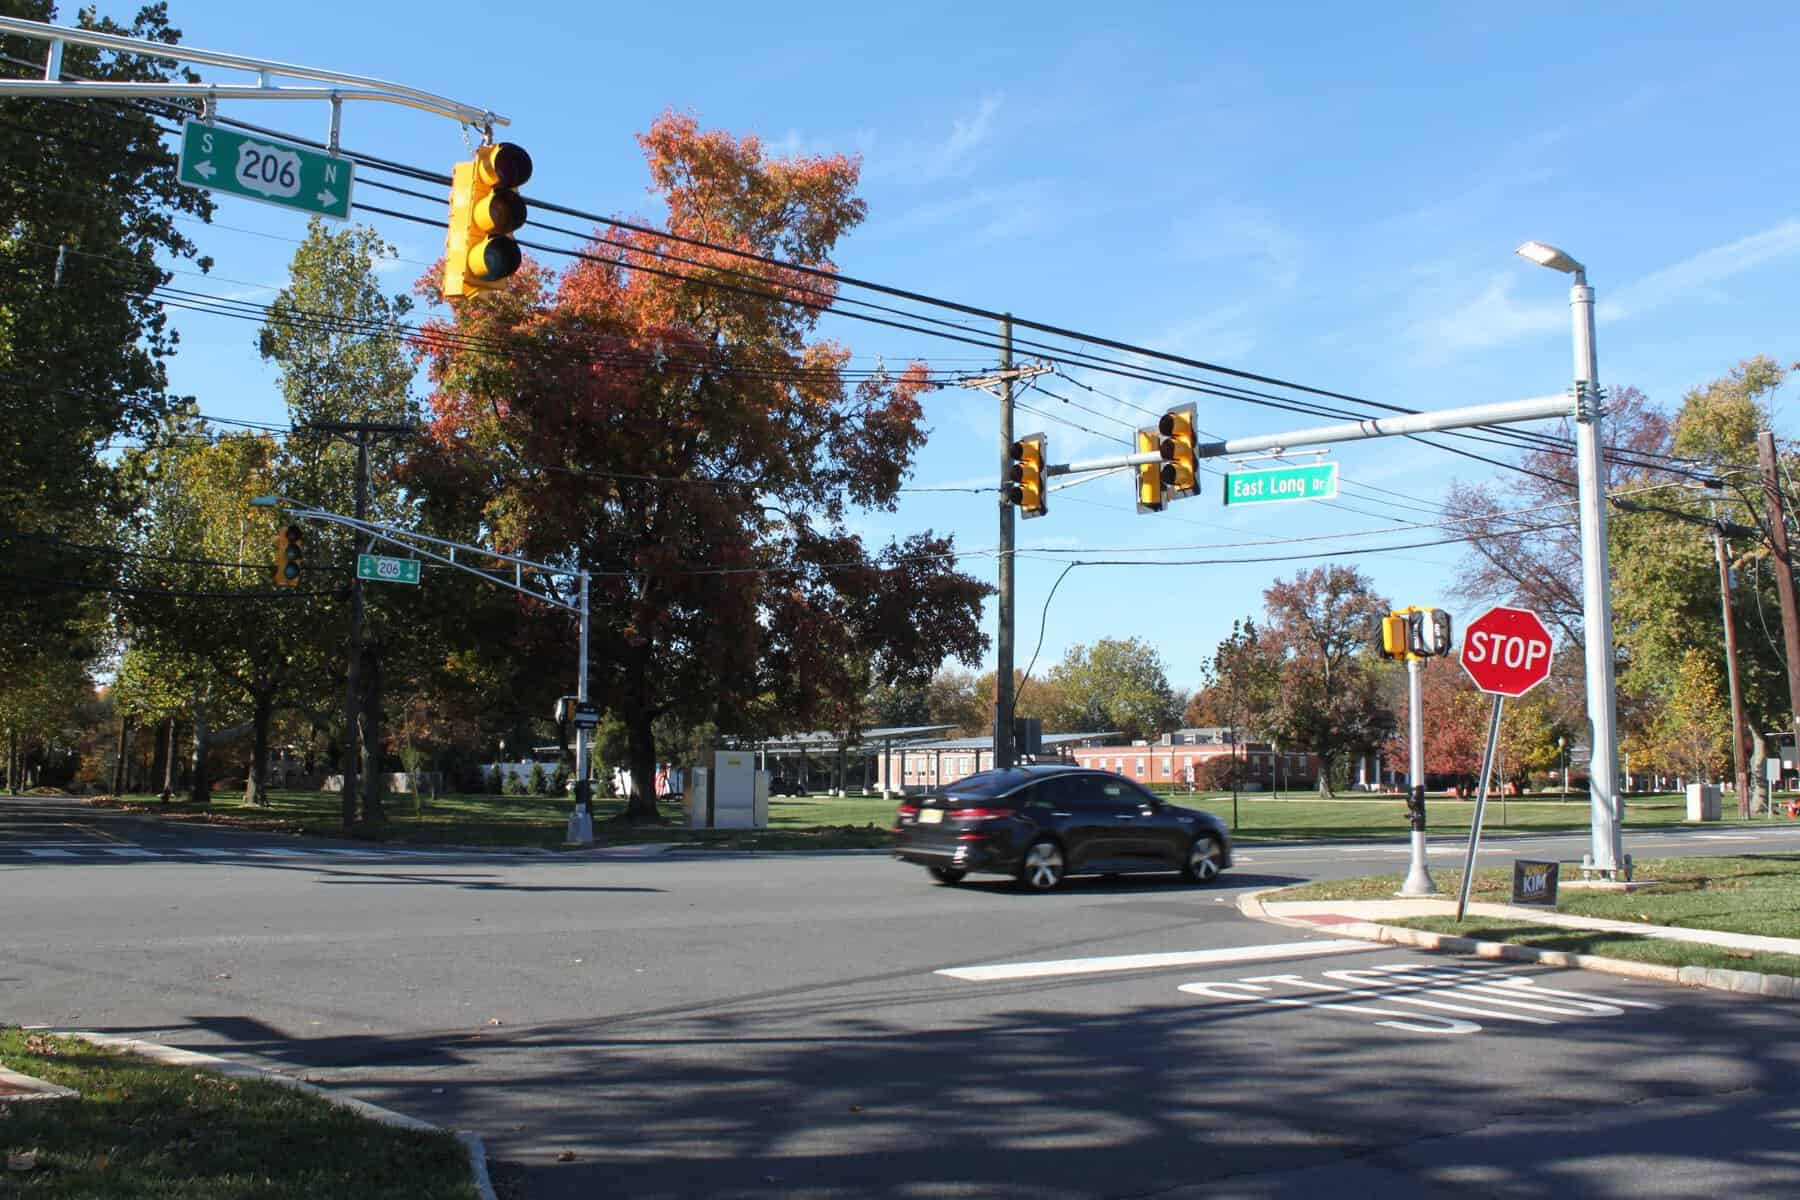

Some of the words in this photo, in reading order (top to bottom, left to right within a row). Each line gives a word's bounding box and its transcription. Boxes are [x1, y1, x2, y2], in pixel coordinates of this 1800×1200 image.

[202, 133, 213, 153] S
[243, 150, 295, 188] 206
[325, 164, 337, 184] N
[1234, 480, 1263, 497] East
[1270, 477, 1305, 496] Long
[379, 562, 399, 575] 206
[1468, 631, 1547, 671] STOP
[1523, 873, 1547, 893] KIM
[1178, 964, 1664, 1033] STOP
